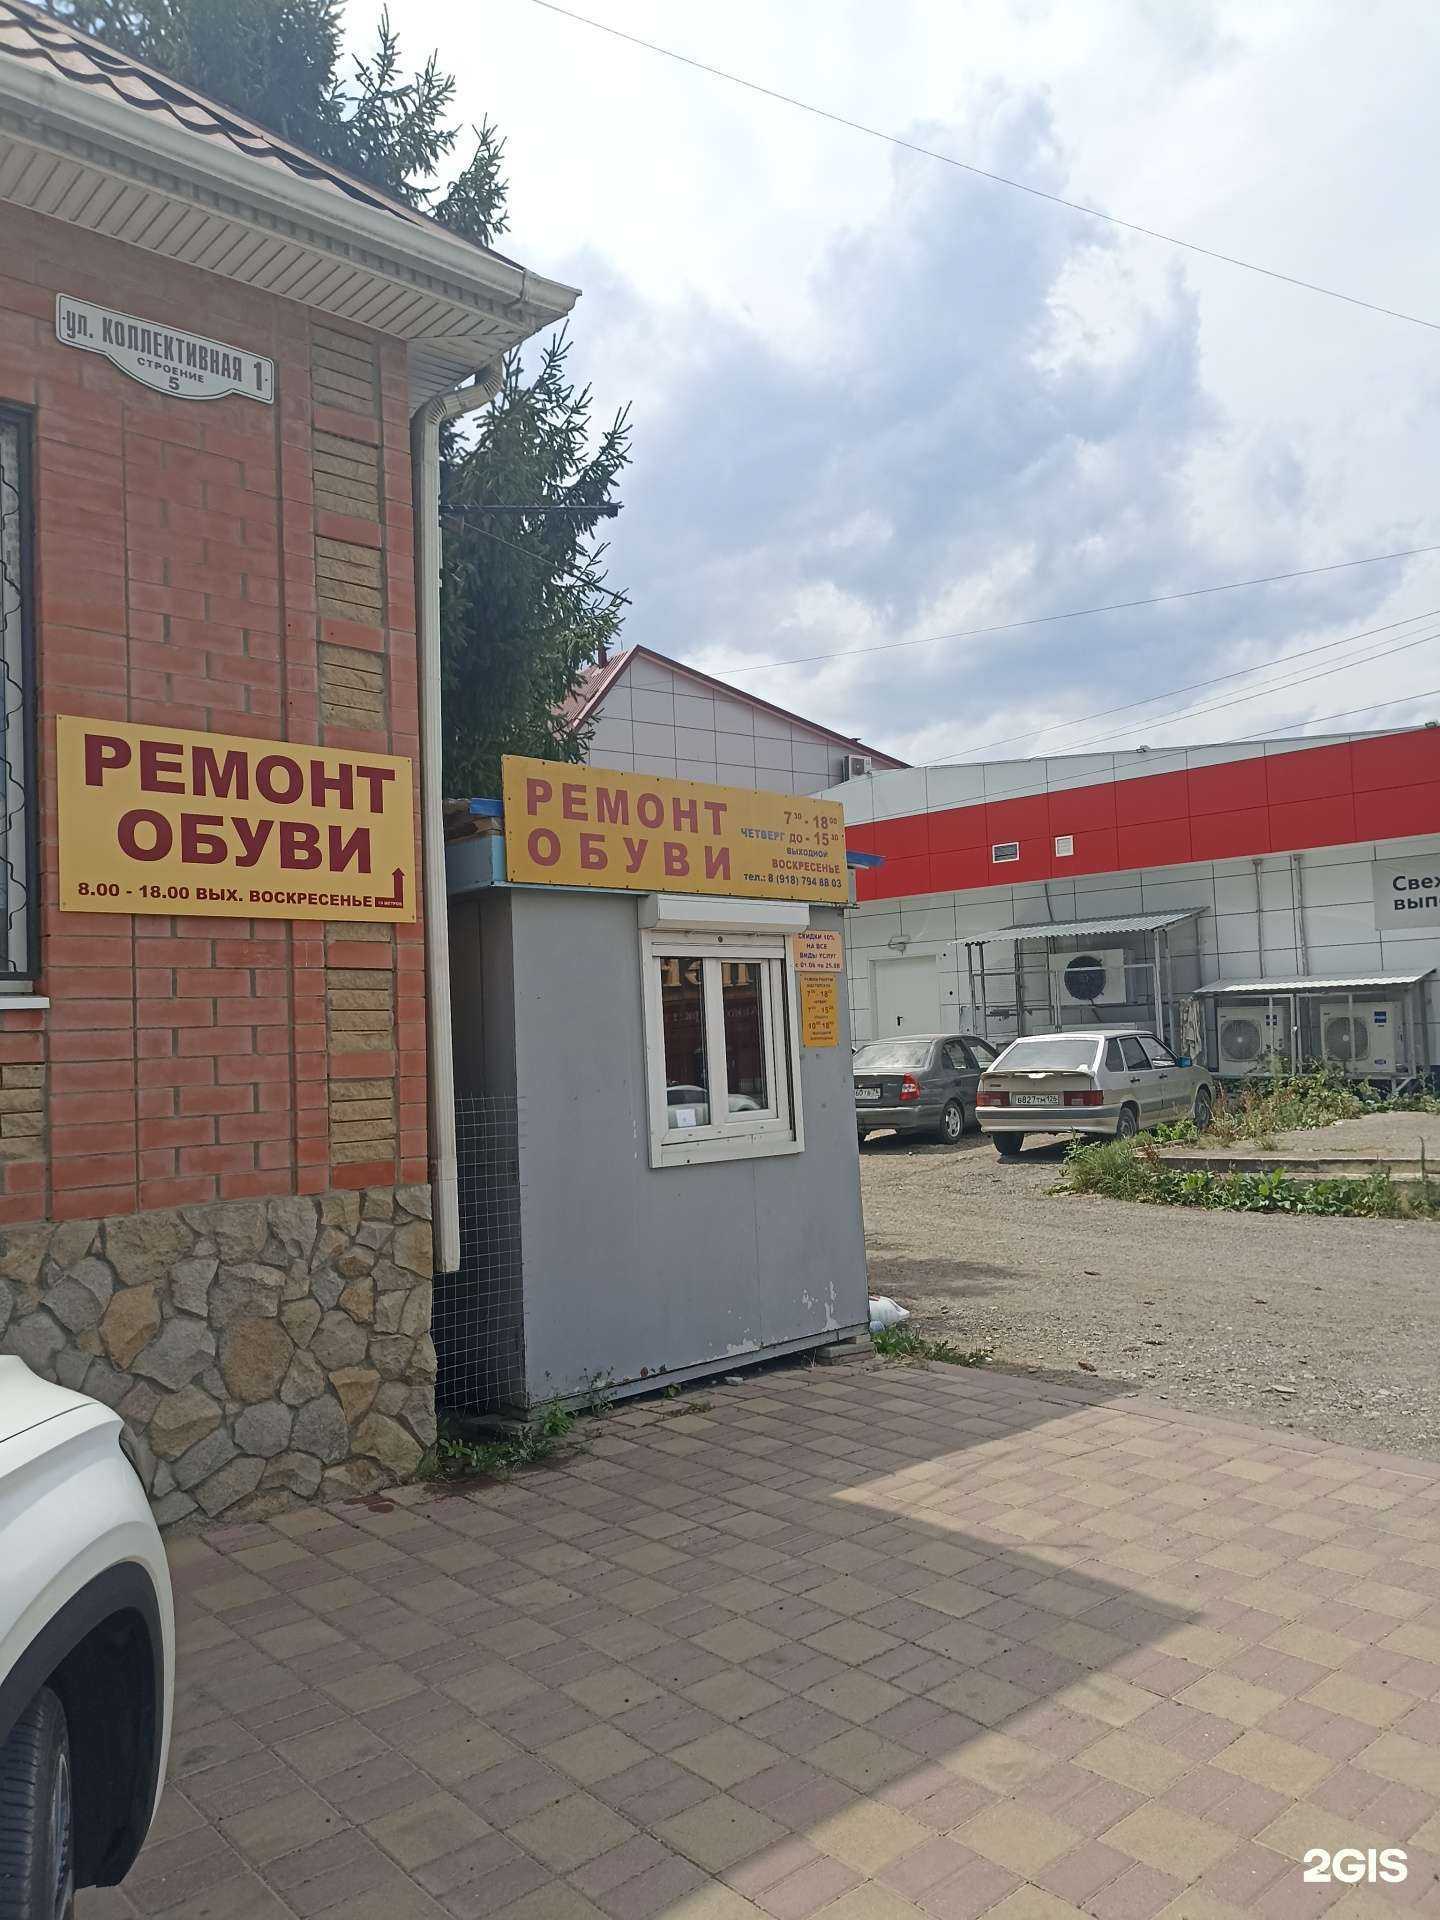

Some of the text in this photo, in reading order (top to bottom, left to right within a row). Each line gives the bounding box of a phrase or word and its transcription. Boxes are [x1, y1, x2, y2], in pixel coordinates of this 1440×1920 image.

[66, 310, 263, 391] ул. КОЛЛЕКТИВНАЯ 1
[137, 357, 204, 383] СТРОЕНИЕ
[168, 376, 180, 391] 5
[84, 734, 396, 814] РЕМОНТ
[526, 778, 728, 836] РЕМОНТ
[117, 808, 371, 875] ОБУВИ
[740, 827, 786, 841] ЧЕТВЕРГ
[789, 833, 803, 845] ДО
[527, 827, 731, 881] ОБУВИ
[772, 859, 841, 874] ВОСКРЕСЕНЬЕ
[768, 873, 774, 882] 8
[776, 874, 799, 886] (918)
[802, 876, 817, 886] 794
[831, 879, 842, 887] 03
[78, 882, 120, 896] 8.00
[139, 885, 190, 900] 18.00
[196, 887, 243, 902] ВЫХ.
[249, 889, 373, 908] ВОСКРЕСЕНЬЕ
[1394, 896, 1440, 910] вып
